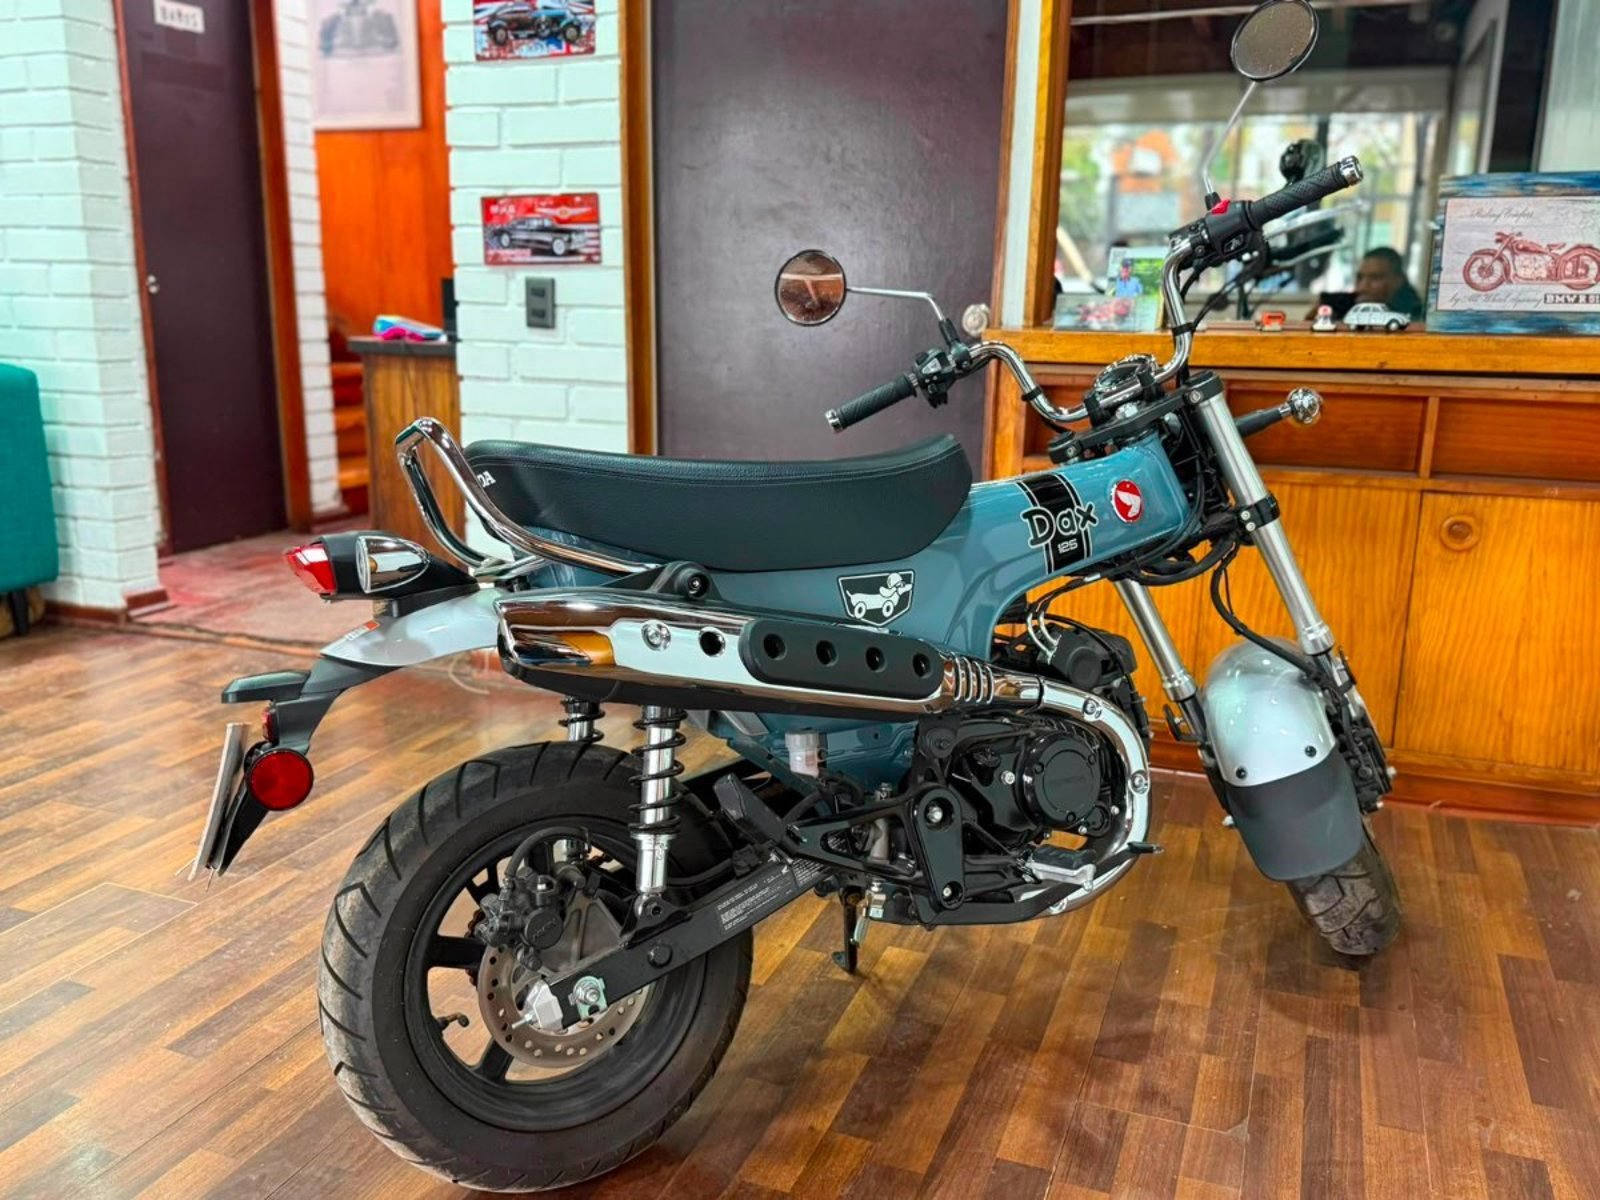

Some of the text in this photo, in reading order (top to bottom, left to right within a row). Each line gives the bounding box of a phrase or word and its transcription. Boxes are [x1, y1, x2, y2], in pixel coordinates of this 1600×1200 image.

[1546, 294, 1577, 304] BMW
[1020, 502, 1099, 549] Dax
[1057, 538, 1078, 554] 125
